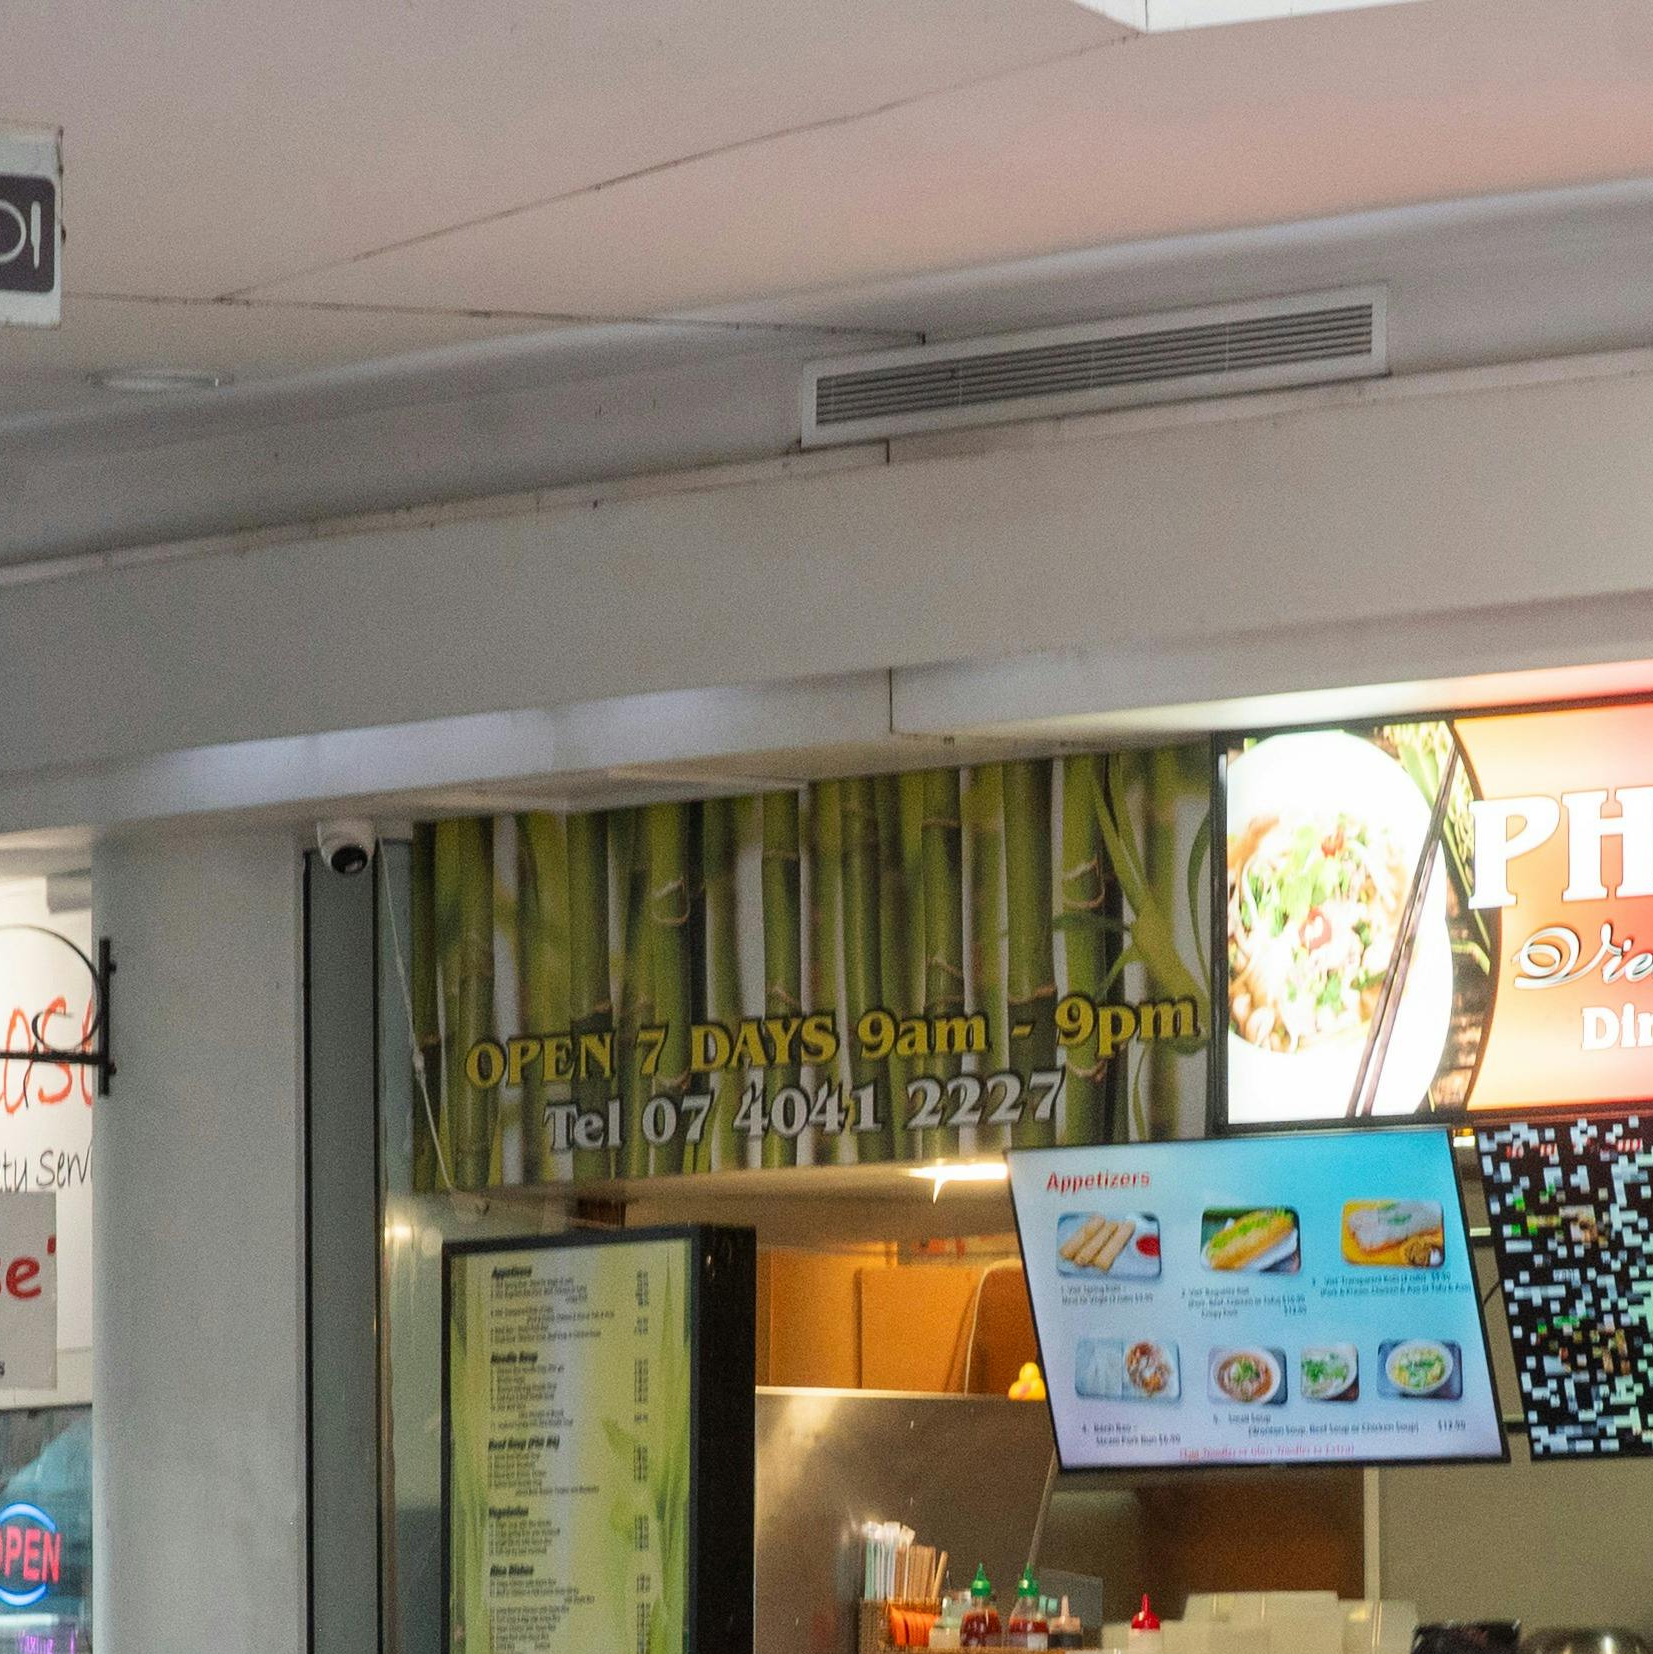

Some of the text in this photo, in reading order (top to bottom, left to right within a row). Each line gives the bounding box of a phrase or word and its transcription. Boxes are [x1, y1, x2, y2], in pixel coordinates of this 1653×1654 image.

[464, 1030, 616, 1090] OPEN
[637, 1027, 669, 1077] 7
[690, 1009, 838, 1074] DAYS
[857, 1004, 990, 1060] 9am
[1052, 994, 1200, 1060] 9pm
[543, 1065, 1066, 1151] Tel 07 4041 2227
[1046, 1170, 1150, 1194] Appetizers
